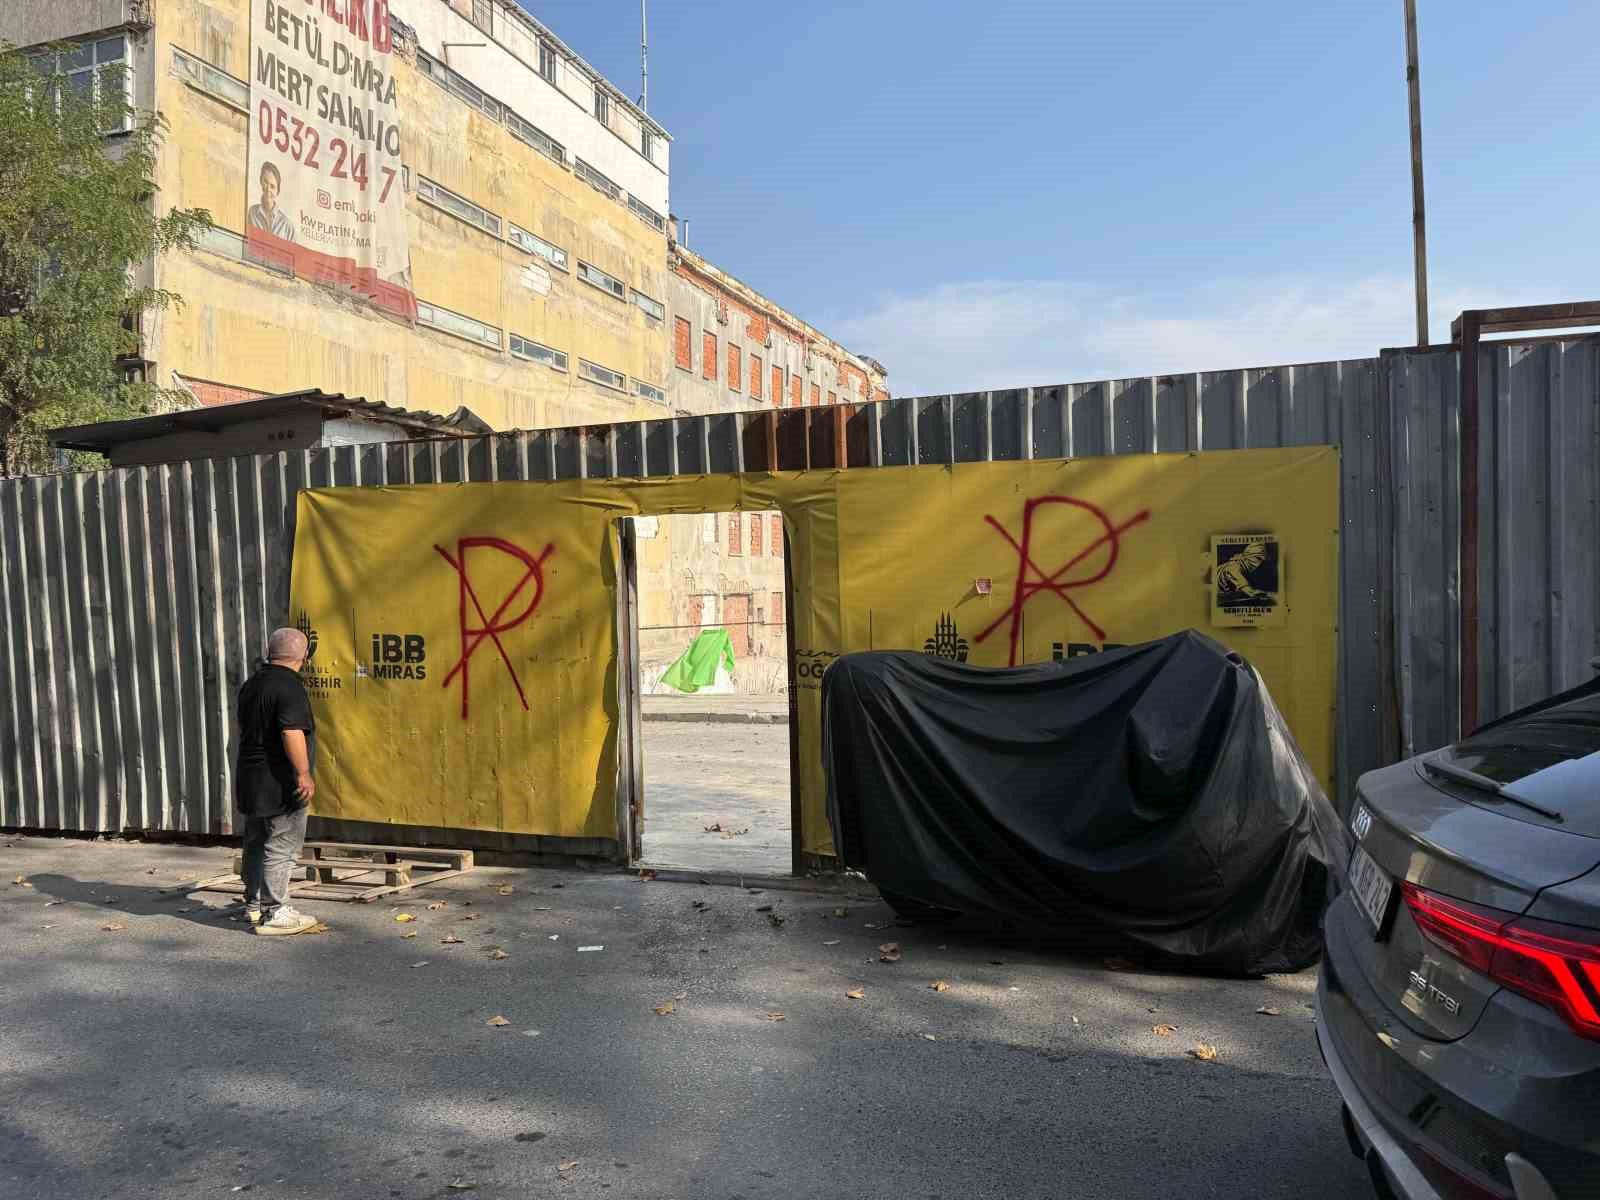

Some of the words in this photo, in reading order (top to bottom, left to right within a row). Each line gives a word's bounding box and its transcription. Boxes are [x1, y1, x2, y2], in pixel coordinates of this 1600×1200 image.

[265, 0, 329, 68] BETÜL
[257, 46, 313, 110] MERT
[259, 99, 320, 170] 0532
[1429, 984, 1460, 1015] TFSI
